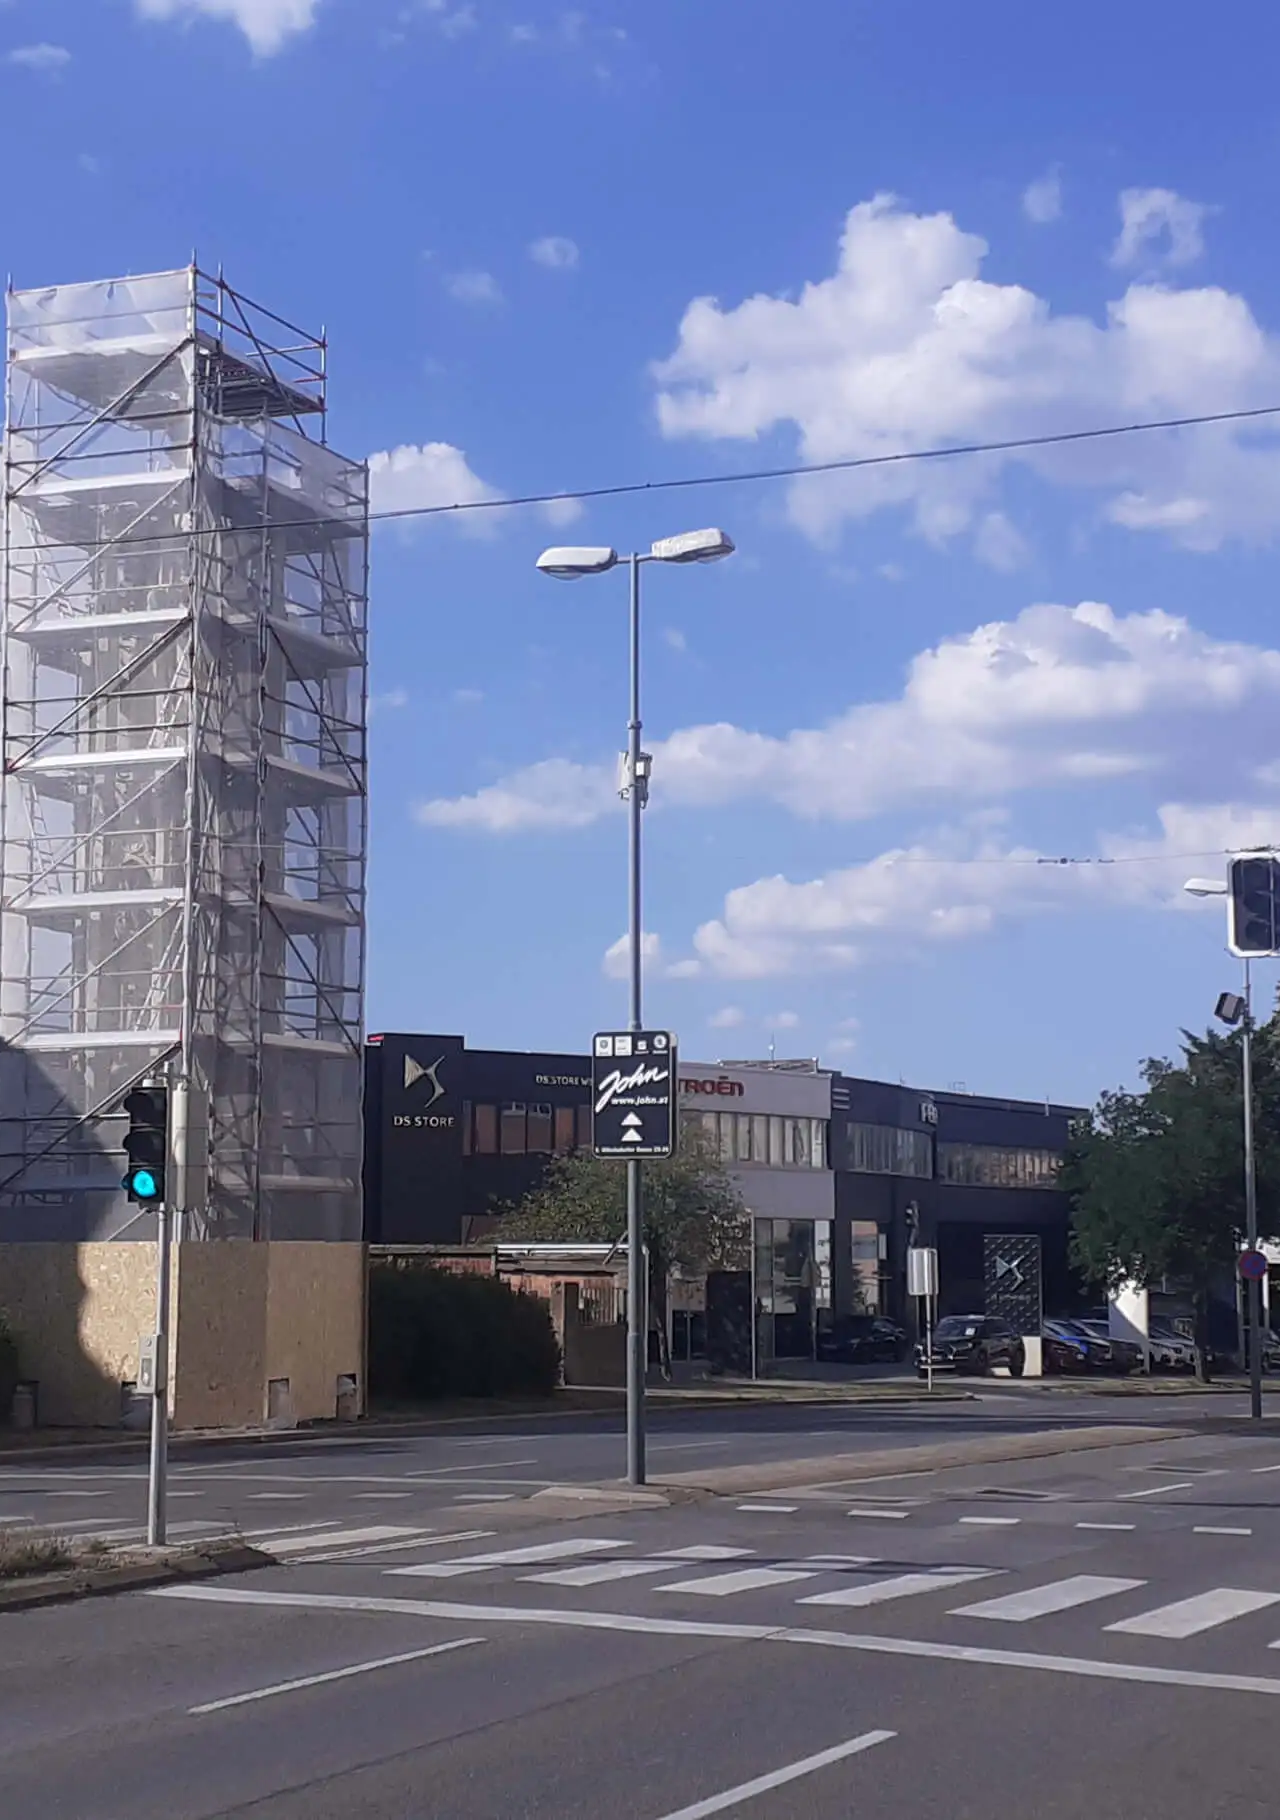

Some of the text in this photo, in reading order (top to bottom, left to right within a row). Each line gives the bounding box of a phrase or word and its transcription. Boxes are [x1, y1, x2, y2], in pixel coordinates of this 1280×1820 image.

[595, 1063, 669, 1113] John
[393, 1115, 455, 1129] DS STORE
